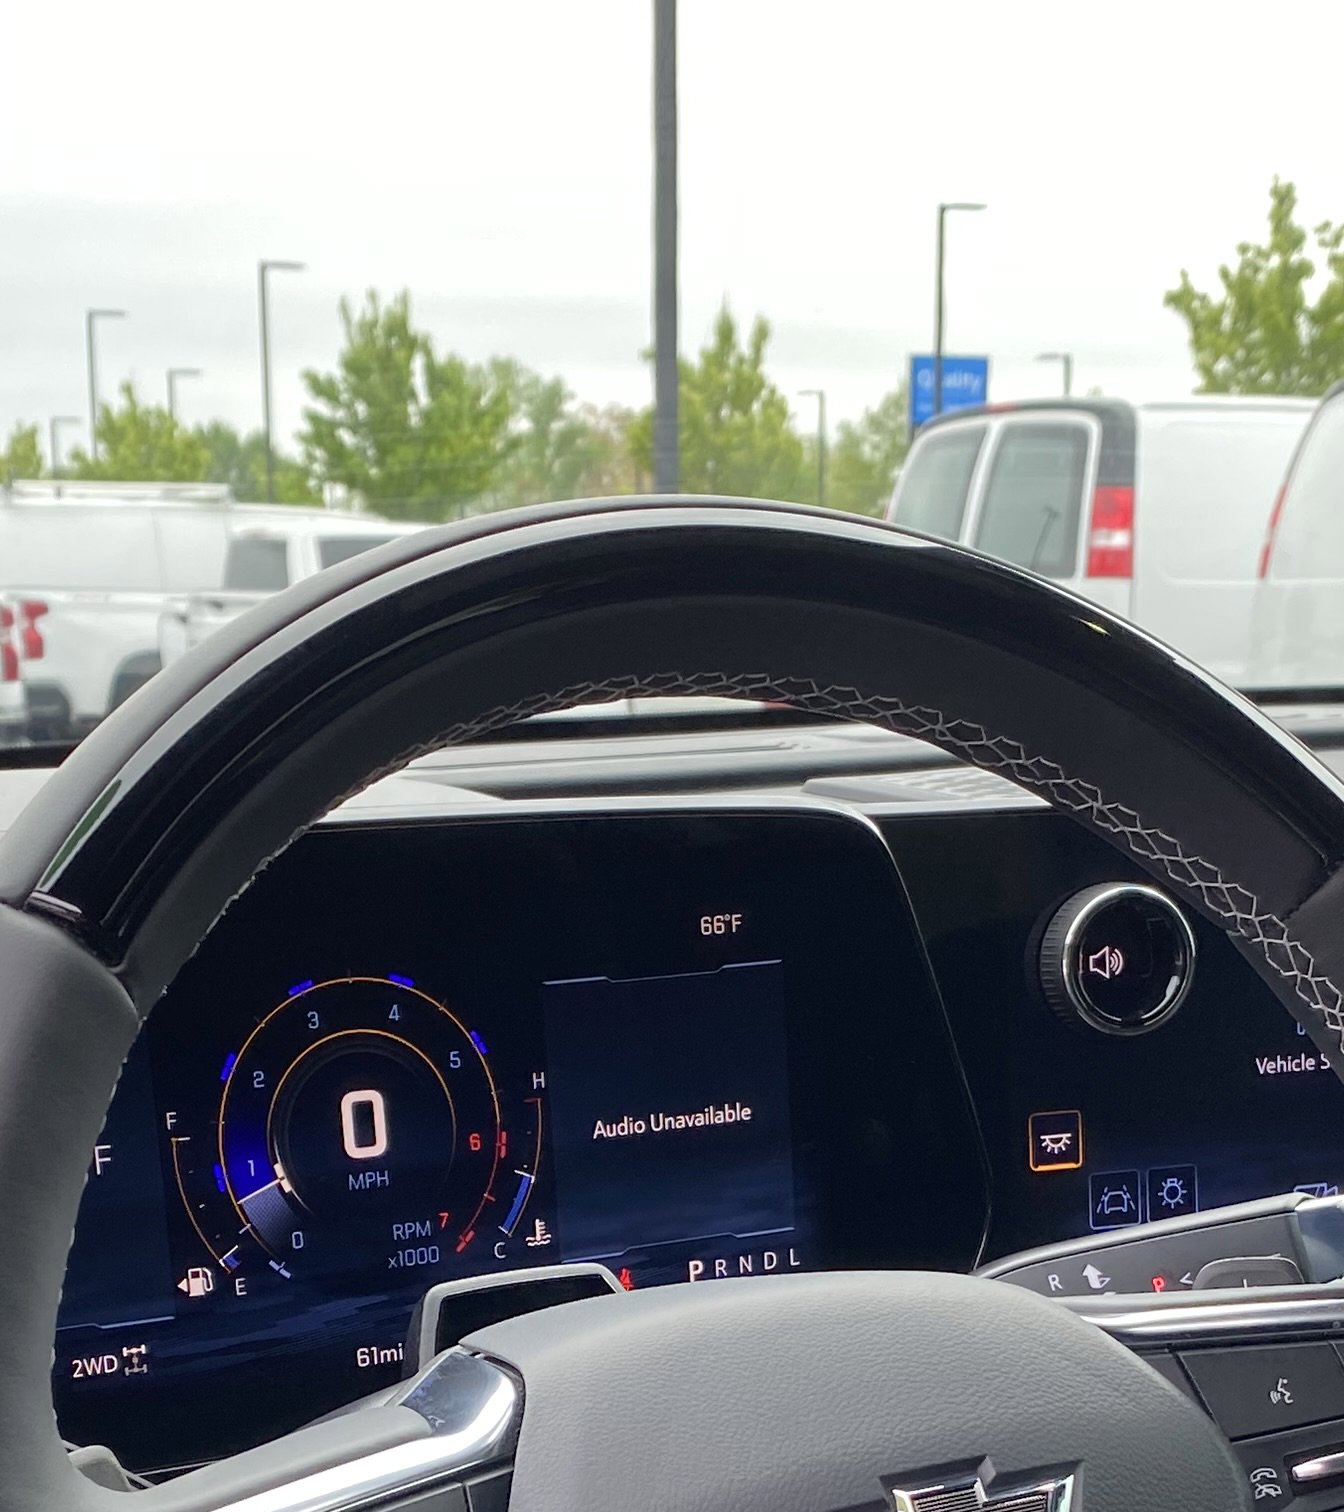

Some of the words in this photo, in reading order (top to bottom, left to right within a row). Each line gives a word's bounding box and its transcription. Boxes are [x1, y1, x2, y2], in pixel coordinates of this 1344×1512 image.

[700, 913, 743, 936] 66°F
[307, 1010, 320, 1029] 3
[388, 1004, 401, 1022] 4
[449, 1051, 461, 1069] 5
[1255, 1053, 1316, 1074] Vehicle
[253, 1070, 265, 1089] 2
[533, 1072, 545, 1089] H
[166, 1112, 177, 1131] F
[340, 1089, 388, 1159] 0
[593, 1115, 646, 1139] Audio
[650, 1103, 752, 1132] Unavailable
[469, 1132, 481, 1151] 6
[247, 1158, 256, 1176] 1
[348, 1169, 390, 1191] MPH
[392, 1219, 432, 1241] RPM
[438, 1212, 449, 1230] 7
[291, 1230, 304, 1250] 0
[388, 1244, 441, 1269] x1000
[493, 1241, 507, 1260] C
[688, 1260, 704, 1283] P
[715, 1259, 728, 1278] R
[739, 1254, 752, 1274] N
[763, 1251, 777, 1270] D
[789, 1248, 800, 1266] L
[235, 1277, 248, 1295] E
[1047, 1274, 1064, 1292] R
[356, 1342, 404, 1367] 61mi
[72, 1353, 118, 1378] 2WD
